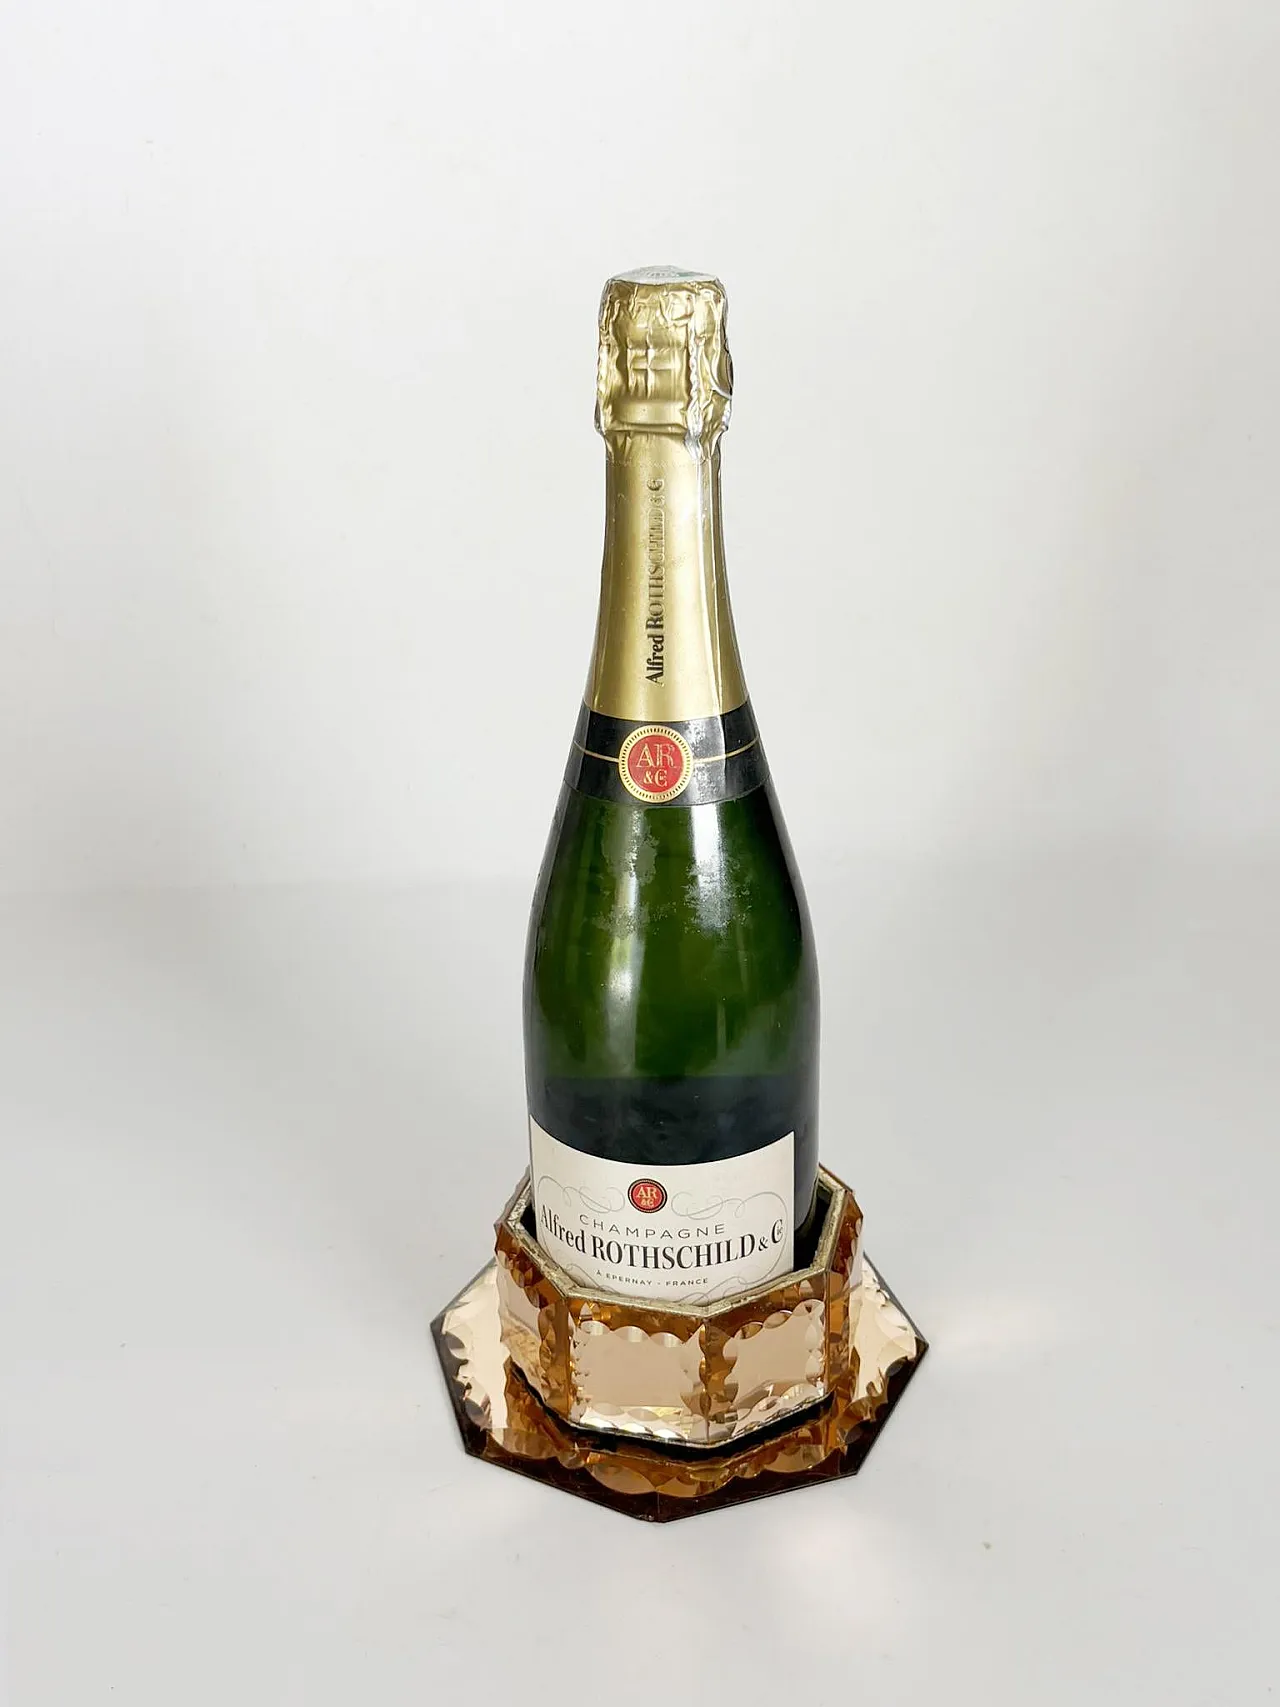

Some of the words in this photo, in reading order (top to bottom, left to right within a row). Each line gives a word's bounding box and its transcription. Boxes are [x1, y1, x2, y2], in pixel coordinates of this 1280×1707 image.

[645, 508, 664, 631] ROTHSCHILD
[645, 634, 664, 685] Alfred
[636, 742, 677, 769] AR
[636, 1186, 659, 1199] AR
[541, 1204, 587, 1255] Alfred
[590, 1233, 756, 1271] ROTHSCHILD
[758, 1236, 769, 1252] &
[579, 1213, 726, 1239] CHAMPAGNE
[665, 1277, 709, 1287] FRANCE
